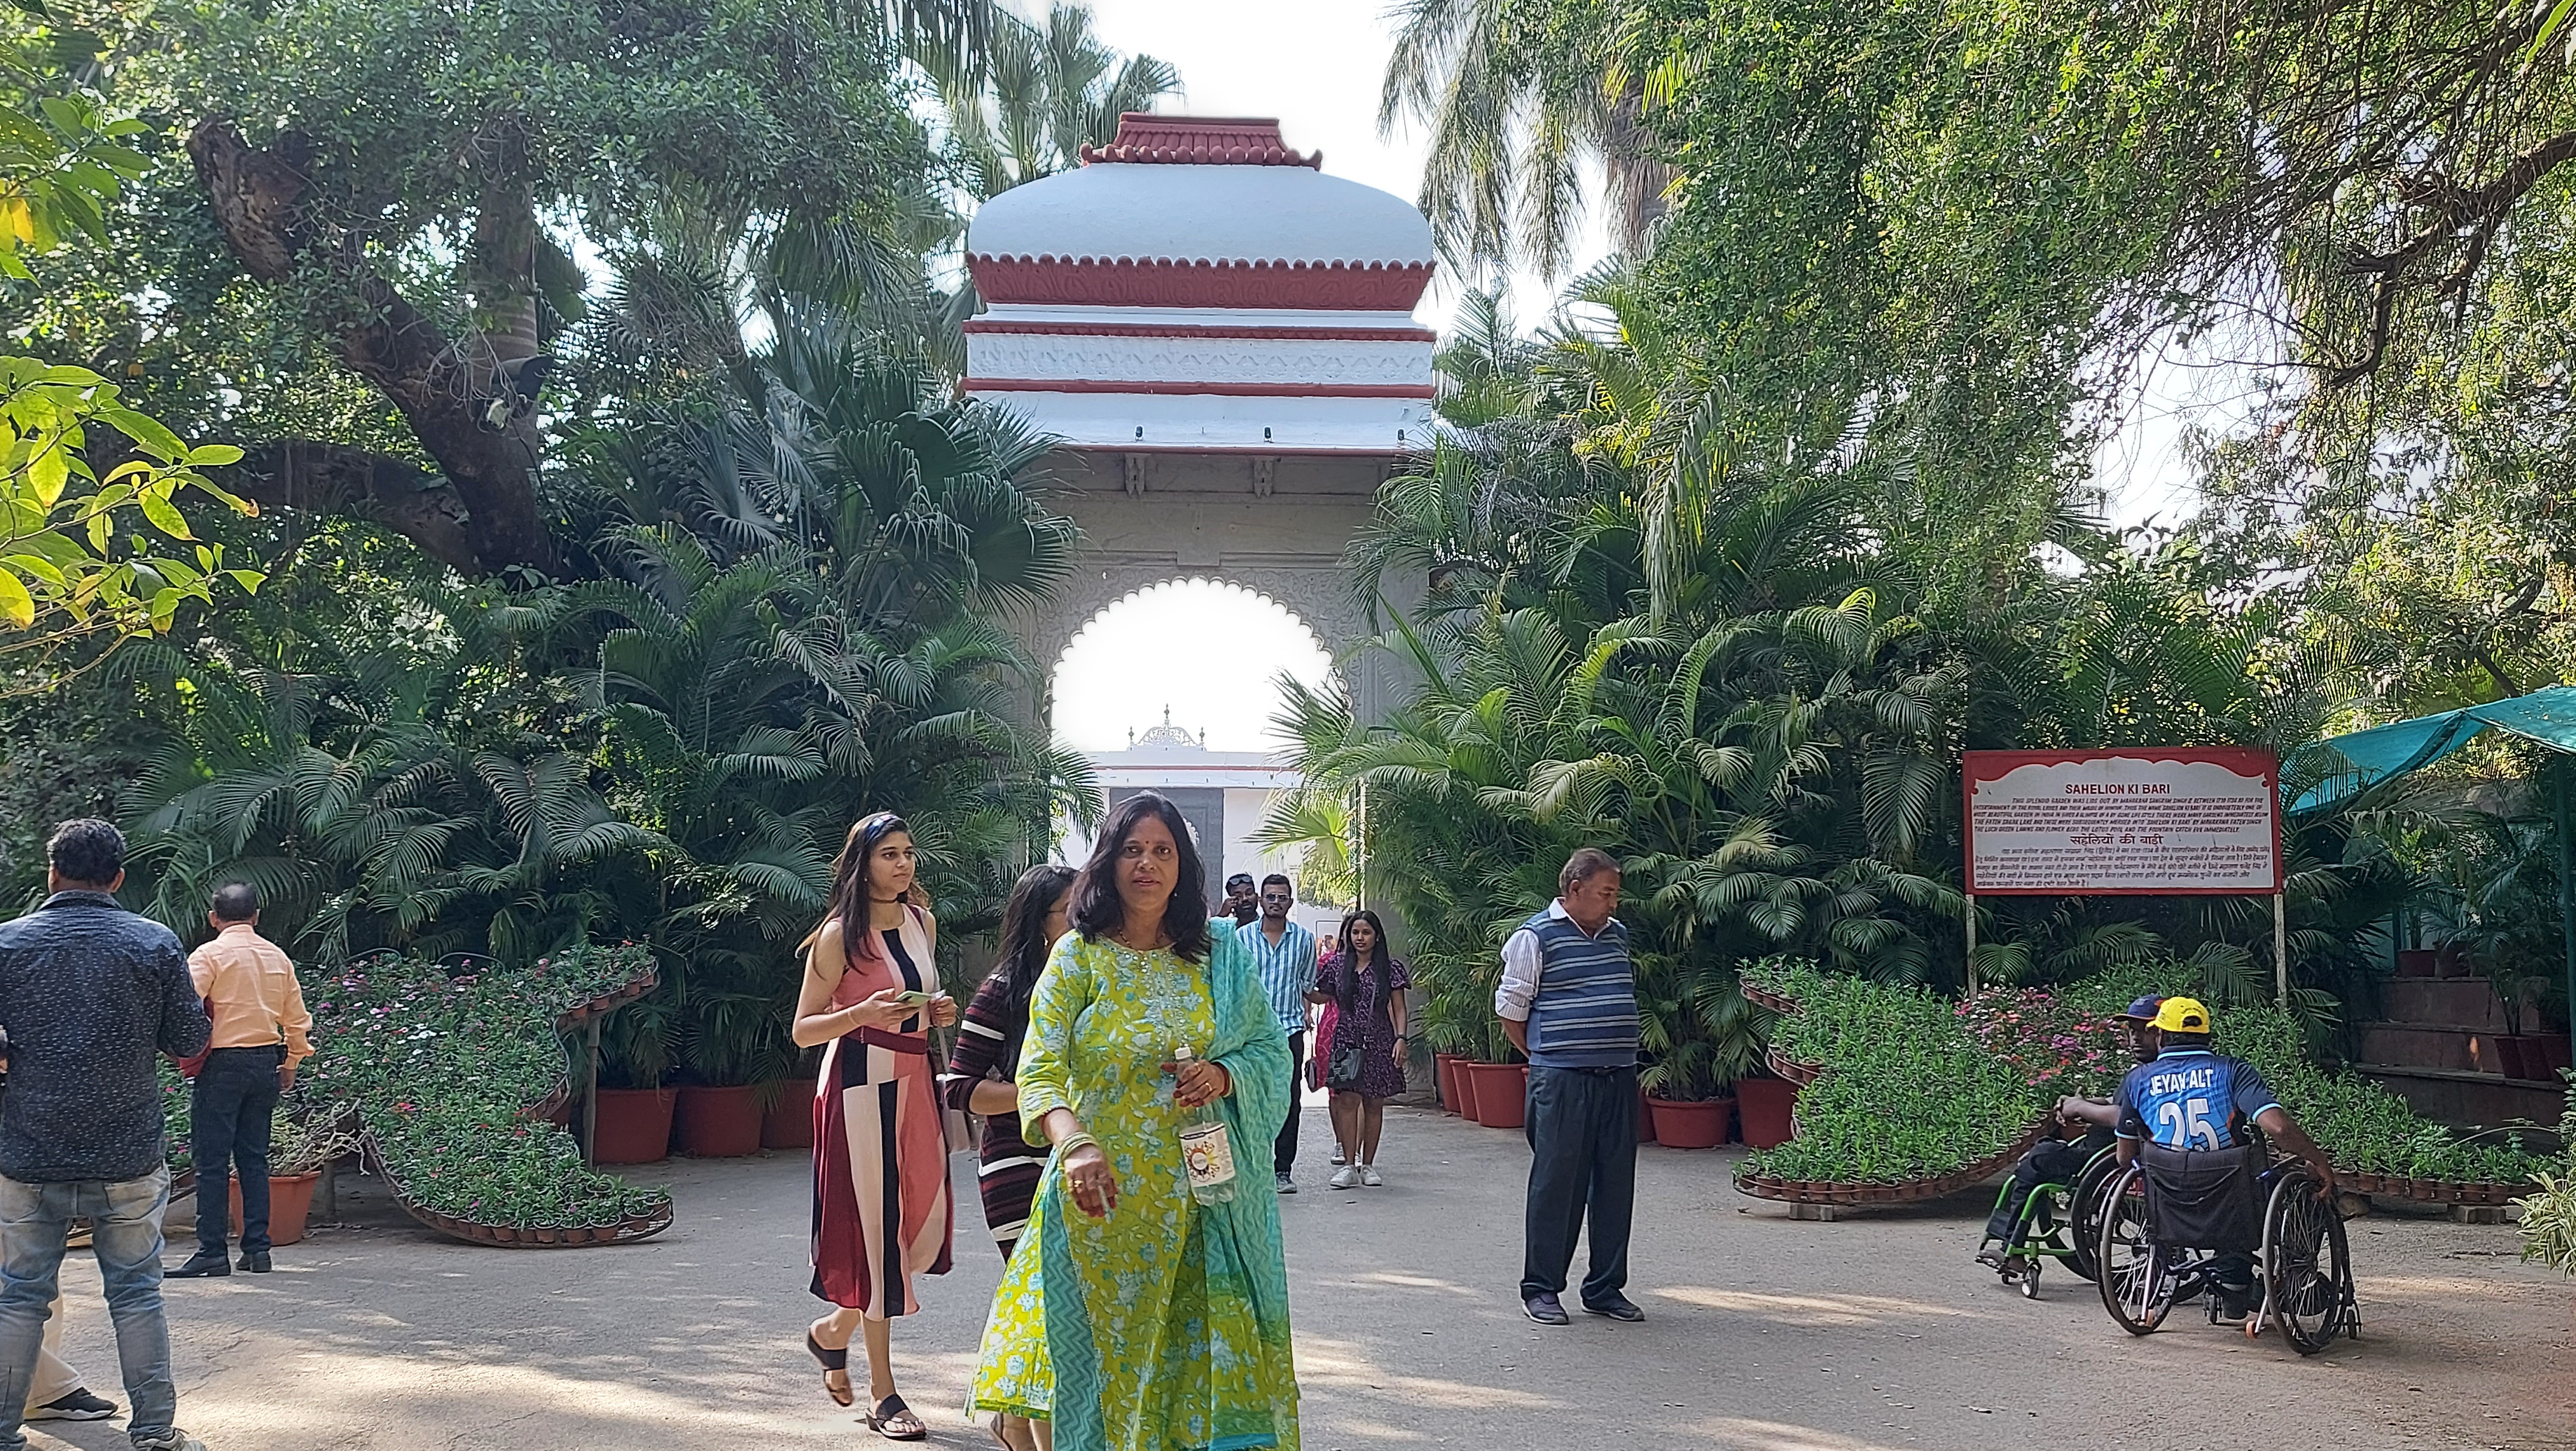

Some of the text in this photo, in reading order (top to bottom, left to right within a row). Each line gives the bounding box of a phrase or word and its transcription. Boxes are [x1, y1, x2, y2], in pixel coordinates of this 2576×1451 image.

[2065, 784, 2170, 794] SAHELION KI BARI
[2119, 834, 2136, 844] की
[2189, 1068, 2213, 1088] ALT
[2159, 1098, 2219, 1152] 25
